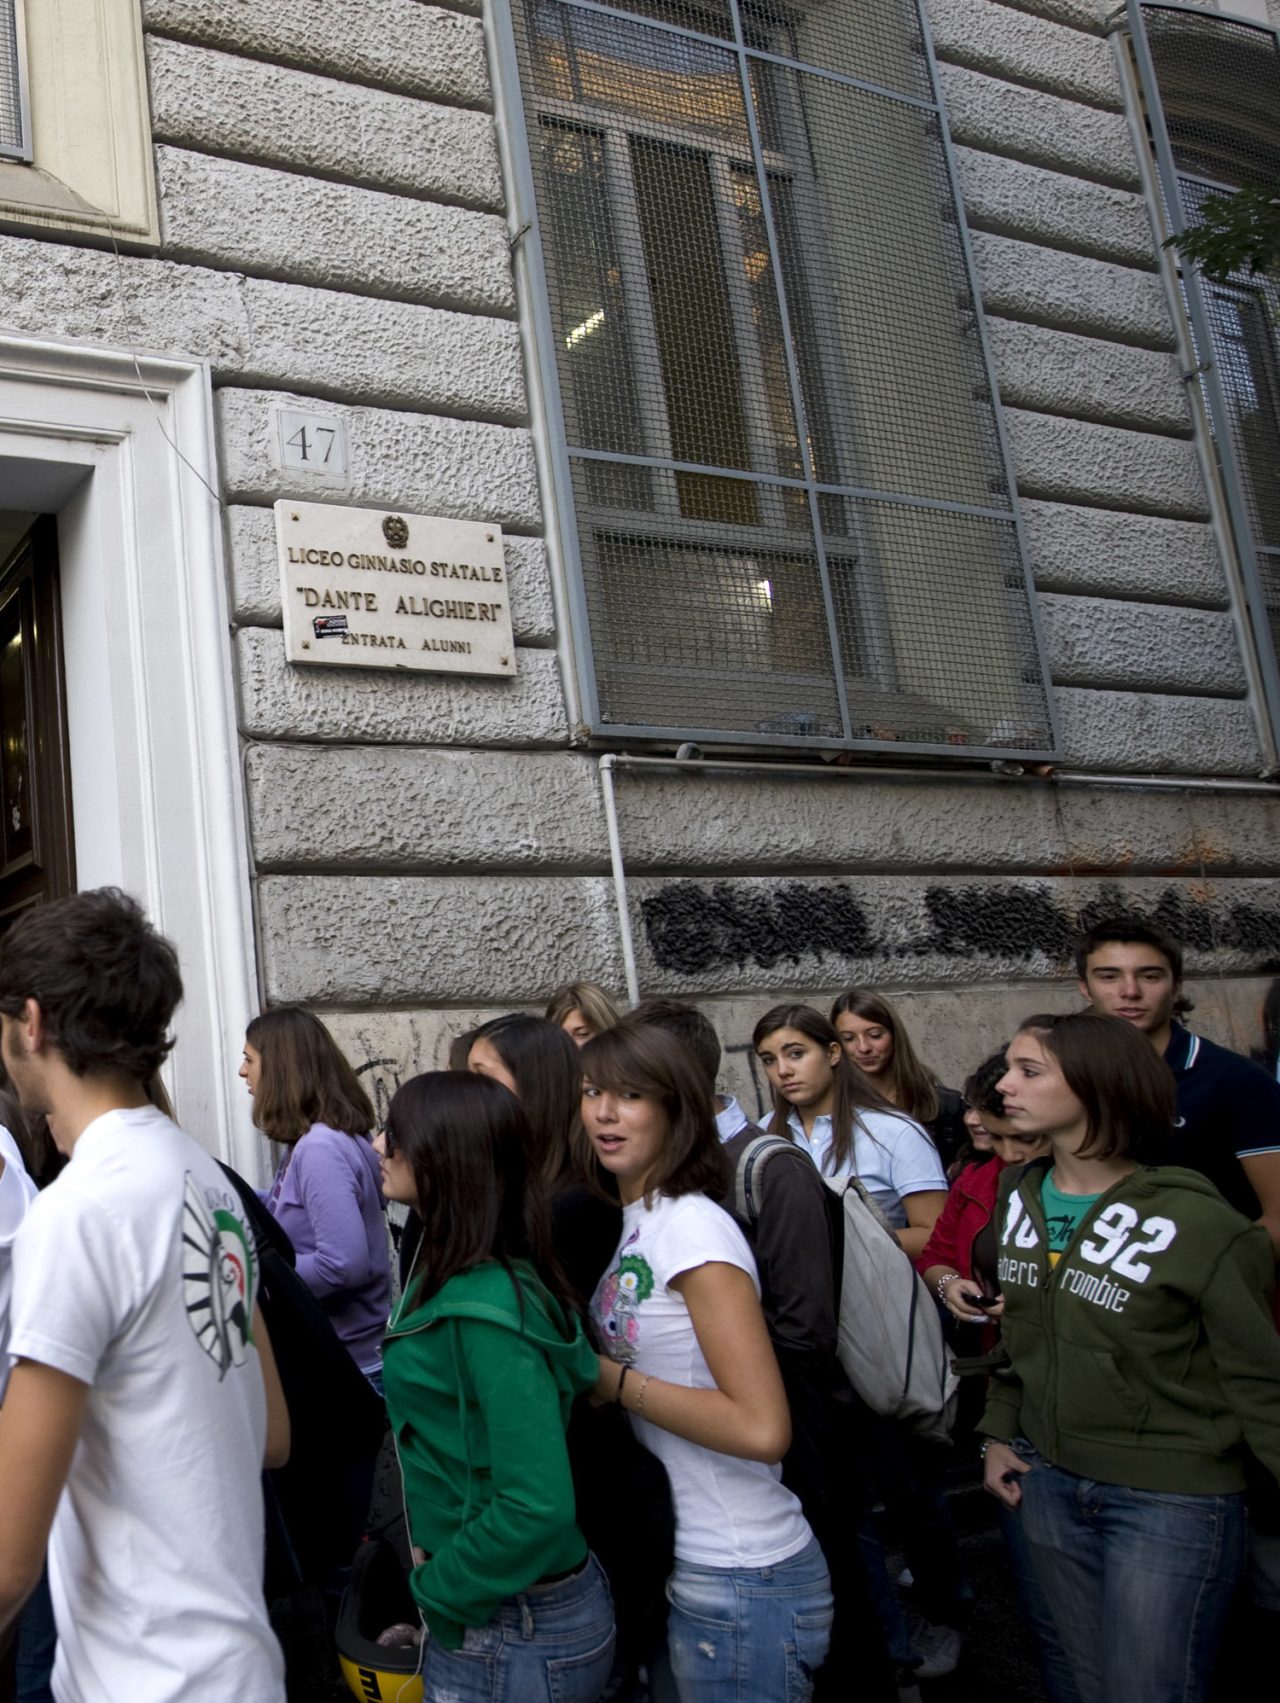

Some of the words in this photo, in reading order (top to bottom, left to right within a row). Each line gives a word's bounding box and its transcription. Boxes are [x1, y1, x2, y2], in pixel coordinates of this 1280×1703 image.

[286, 425, 336, 463] 47
[288, 547, 343, 567] LICEO
[347, 554, 426, 575] GINNASIO
[430, 562, 503, 582] STATALE
[342, 633, 406, 649] ENTRATA
[422, 639, 471, 655] ALUNNI
[1080, 1202, 1177, 1284] 92
